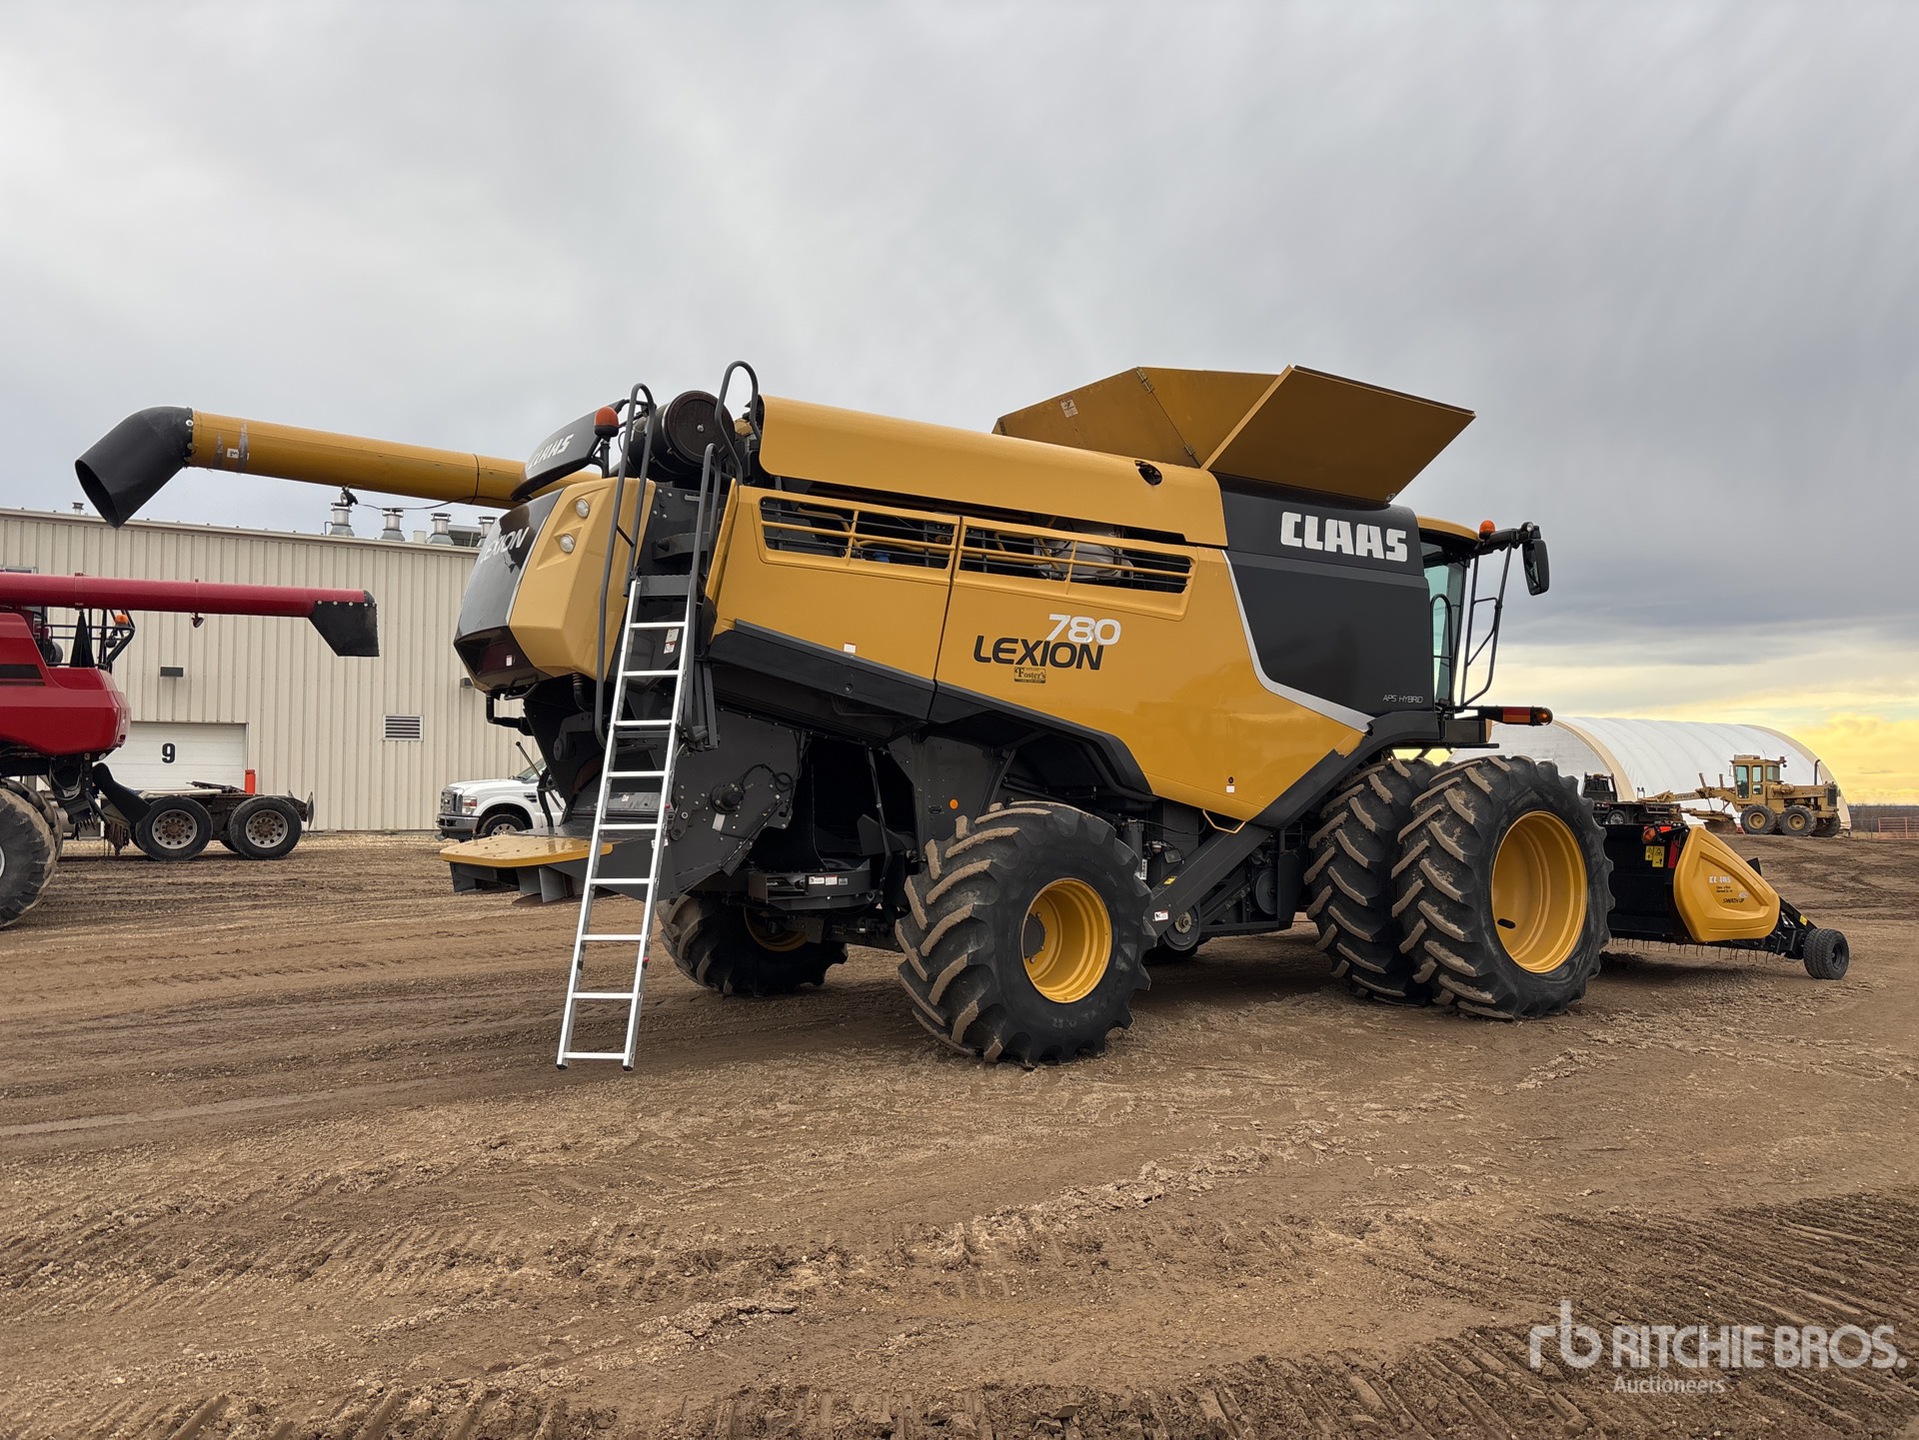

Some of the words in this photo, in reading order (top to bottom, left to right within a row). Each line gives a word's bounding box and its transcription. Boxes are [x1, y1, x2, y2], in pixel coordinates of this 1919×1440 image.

[1280, 511, 1408, 563] CLAAS
[1046, 613, 1122, 646] 780
[973, 635, 1104, 671] LEXION
[1382, 694, 1397, 703] APS
[161, 742, 176, 764] 9
